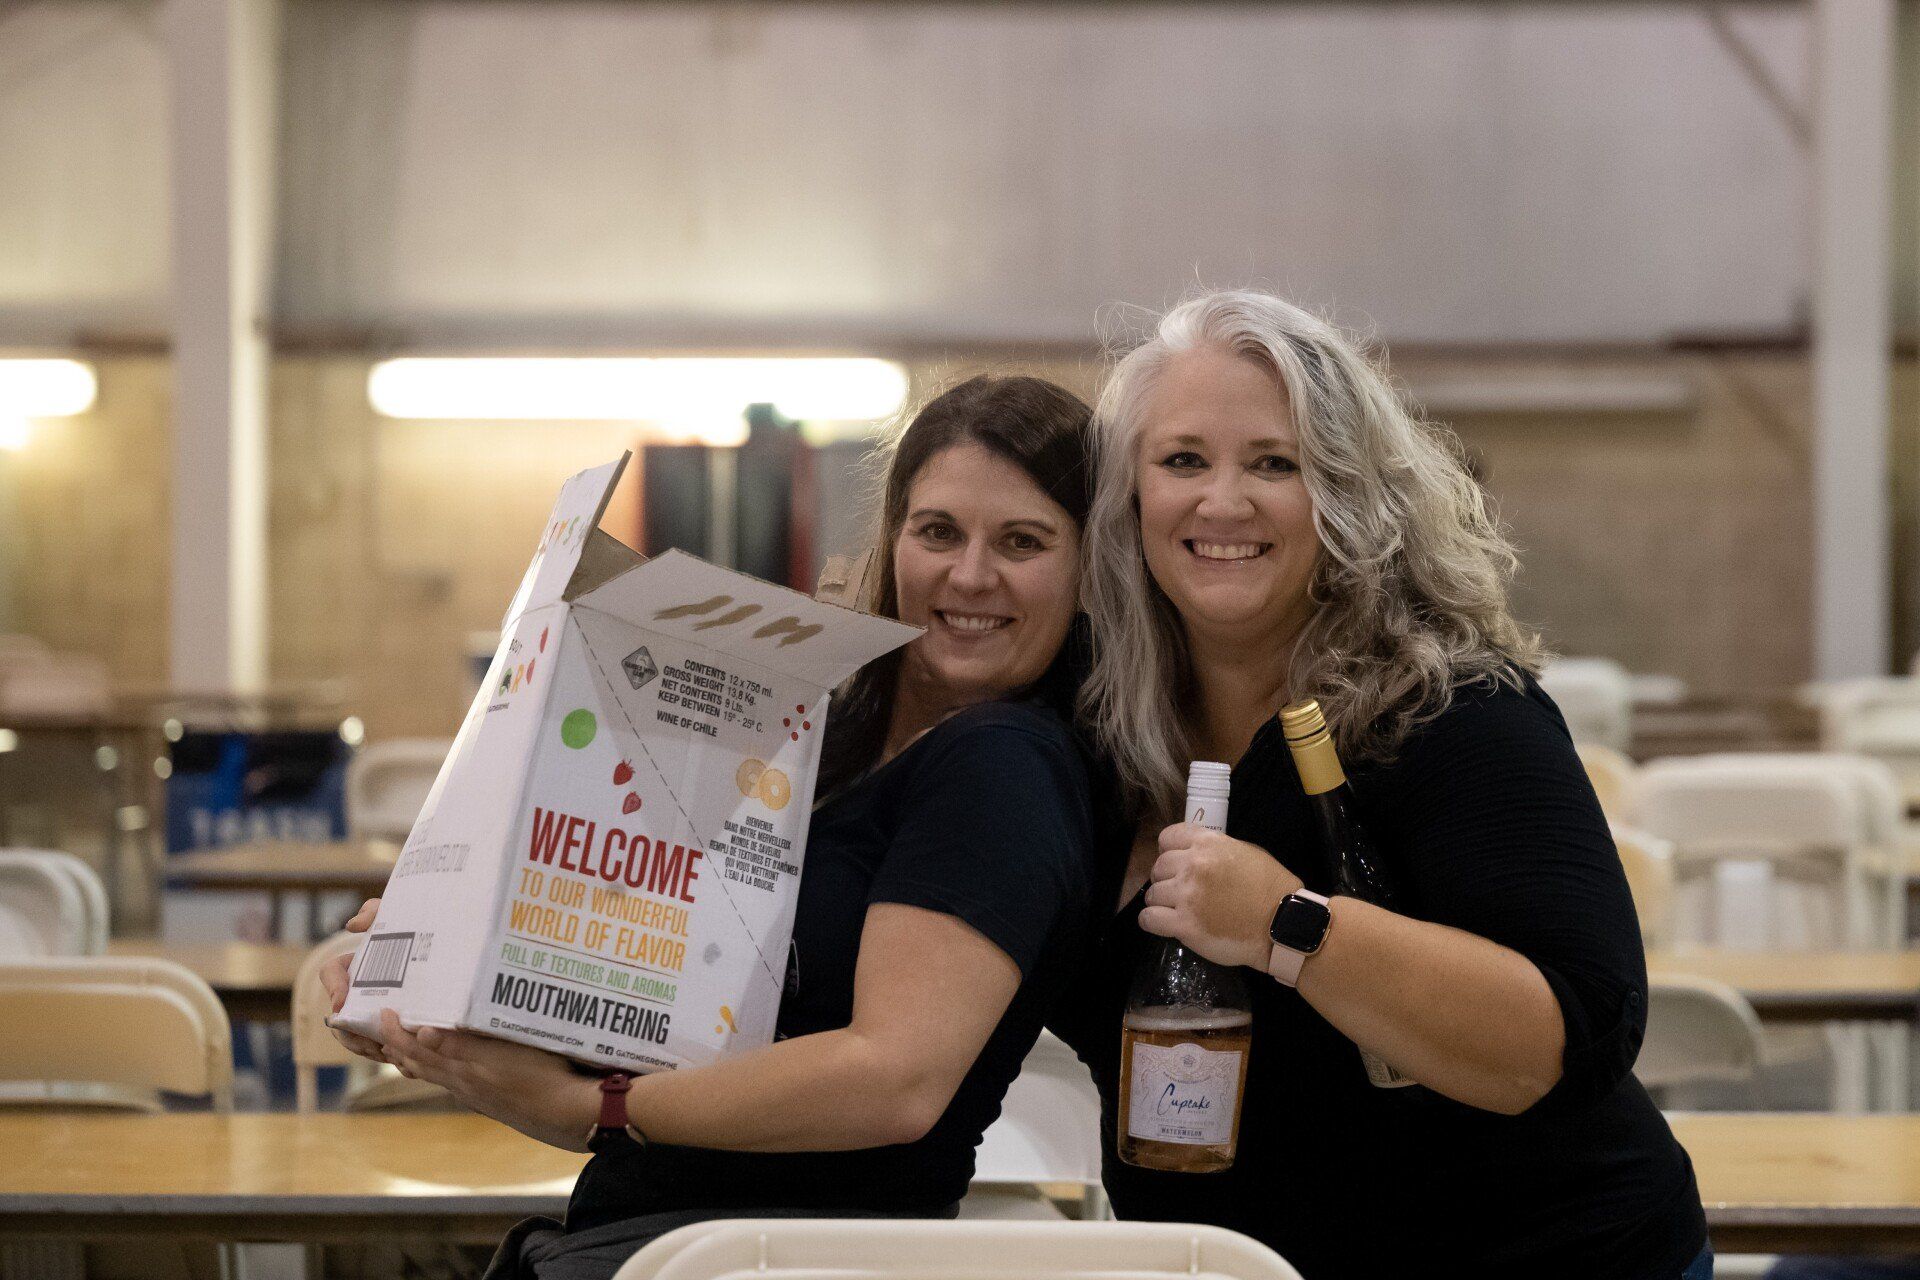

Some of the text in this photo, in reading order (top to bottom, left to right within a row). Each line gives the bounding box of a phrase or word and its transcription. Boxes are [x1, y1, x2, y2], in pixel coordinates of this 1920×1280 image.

[661, 678, 744, 714] NET CONTENTS 9 Lts.
[663, 665, 692, 683] GROSS
[694, 674, 725, 693] WEIGHT
[744, 693, 756, 706] Kg.
[684, 659, 773, 698] CONTENTS 12 x 750 ml.
[656, 710, 718, 737] WINE OF CHILE
[658, 690, 680, 705] KEEP
[681, 697, 720, 718] BETWEEN
[756, 722, 764, 733] C.
[723, 820, 792, 850] DANS NOTRE MERVEILLEUX
[745, 816, 774, 833] BIENVENUE
[529, 806, 704, 904] WELCOME
[709, 839, 799, 877] REMPLI DE TEXTURES ET D'ARÔMES
[730, 834, 782, 859] MONDE DE SAVEURS
[724, 856, 780, 882] QUI VOUS METTRONT
[724, 868, 739, 881] L'EAU
[745, 875, 752, 885] LA
[519, 867, 690, 938] TO OUR WONDERFUL
[509, 899, 687, 973] WORLD OF FLAVOR
[500, 943, 677, 1002] FULL OF TEXTURES AND AROMAS
[491, 972, 671, 1045] MOUTHWATERING
[1156, 1082, 1211, 1116] Cupcake
[1161, 1127, 1202, 1137] WATERMELON
